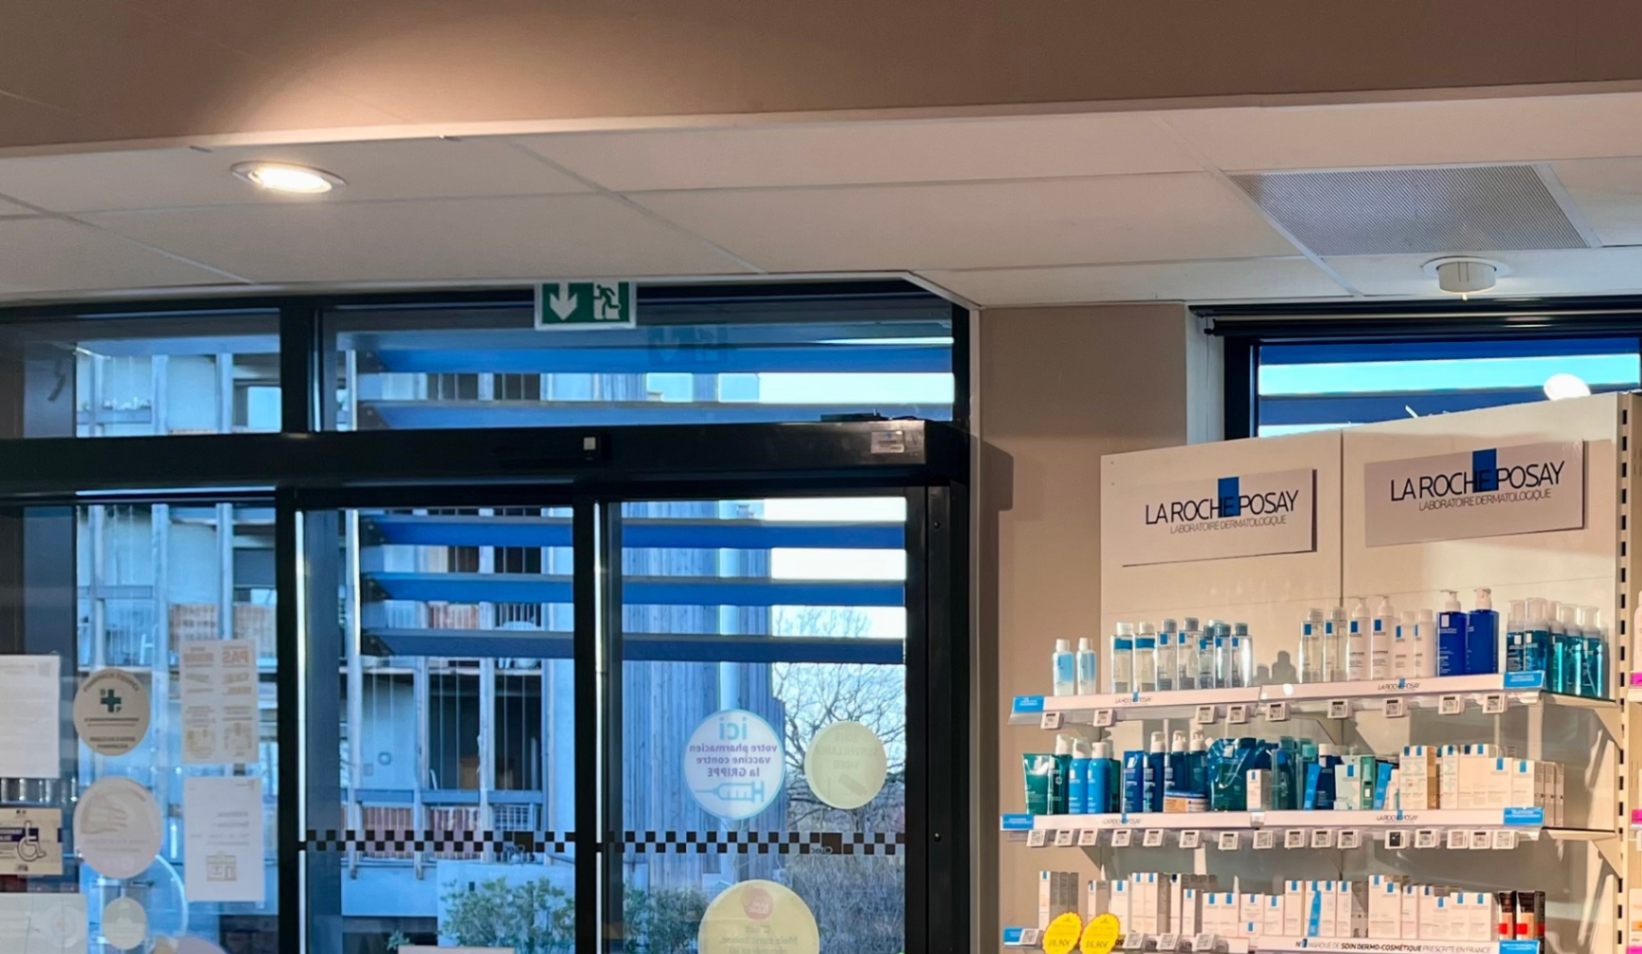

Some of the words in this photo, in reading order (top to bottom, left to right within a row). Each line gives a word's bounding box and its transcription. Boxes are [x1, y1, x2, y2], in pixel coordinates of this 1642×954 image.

[1391, 479, 1416, 501] LA
[1419, 470, 1492, 499] ROCHE
[1496, 461, 1565, 490] POSAY
[1145, 504, 1168, 525] LA
[1171, 497, 1235, 522] ROCHE
[1239, 490, 1298, 516] POSAY
[1419, 495, 1474, 512] LABORATOIRE
[1475, 488, 1551, 507] DERMATOLOGIQUE
[1170, 520, 1218, 535] LABORATOIRE
[1219, 515, 1286, 530] DERMATOLOGIQUE
